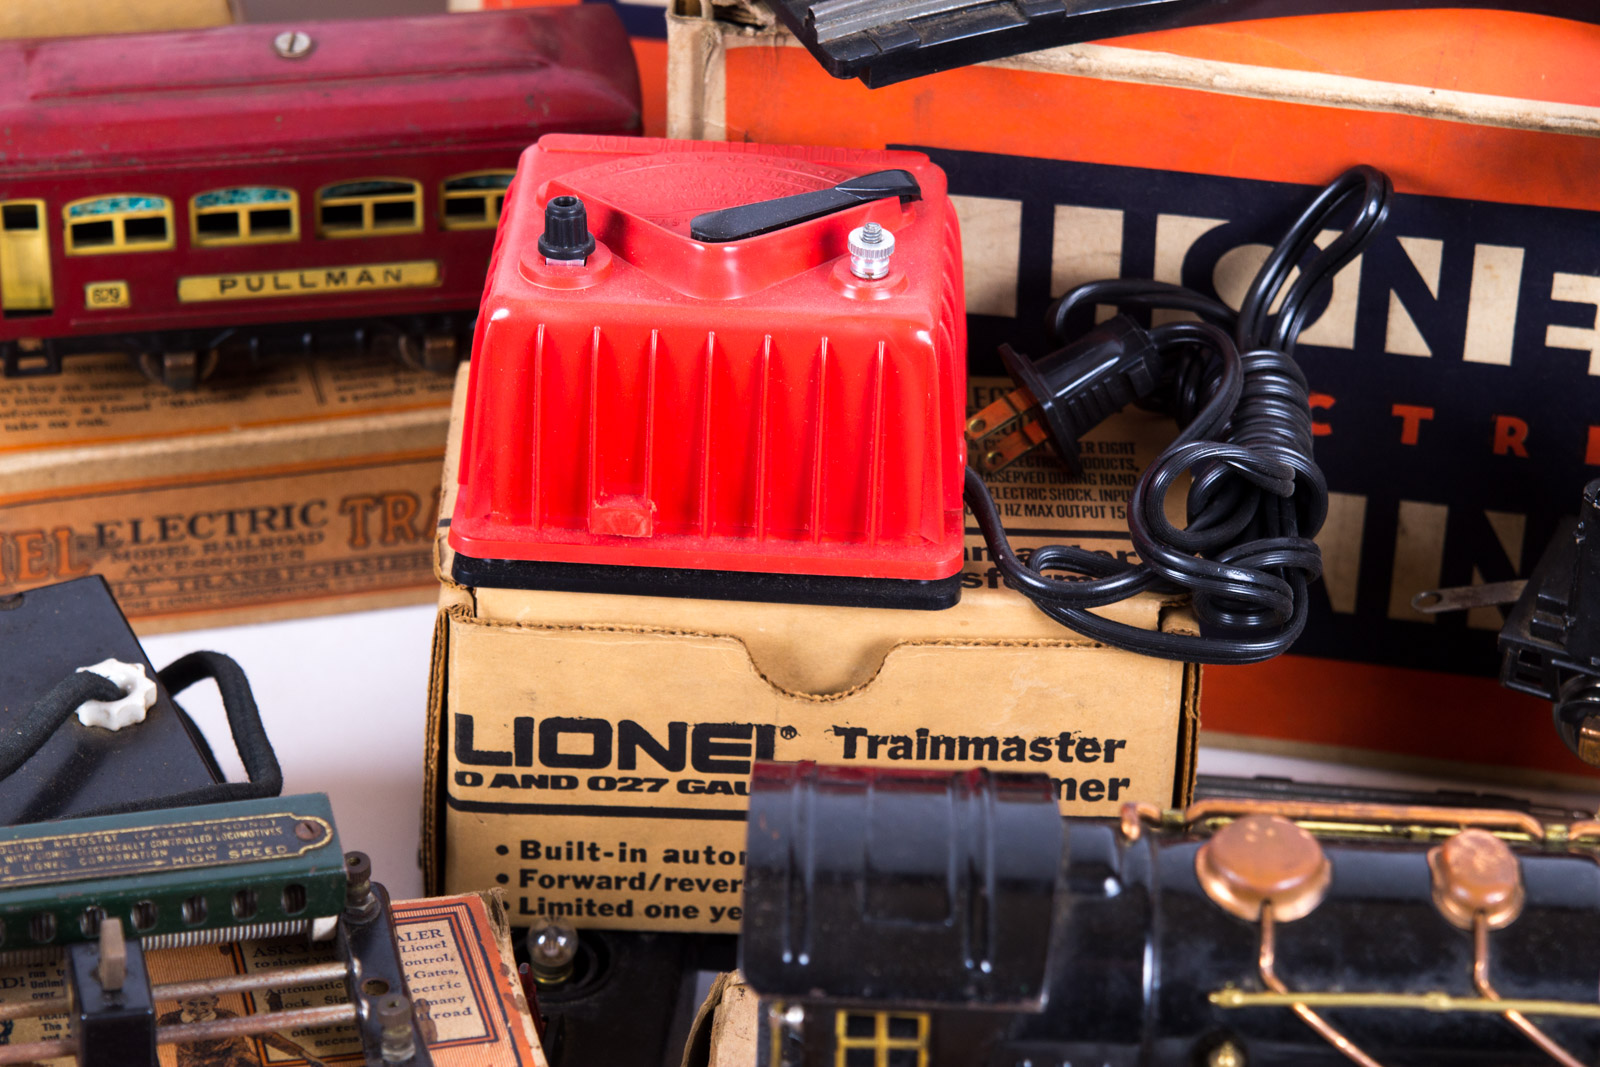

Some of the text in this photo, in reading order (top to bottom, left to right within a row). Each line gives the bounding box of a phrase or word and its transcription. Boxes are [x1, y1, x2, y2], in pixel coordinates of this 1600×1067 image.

[219, 268, 402, 294] PULLMAN
[1098, 442, 1136, 456] EIGHT
[1080, 457, 1140, 472] ODUCTS,
[988, 487, 1049, 500] ELECTRIC
[1050, 488, 1097, 501] SHOCK.
[1005, 503, 1021, 516] HZ
[1024, 505, 1056, 517] MAX
[1056, 505, 1107, 518] OUTPUT
[95, 499, 329, 549] ELECTRIC
[202, 530, 325, 558] RAILROAD
[832, 725, 1127, 763] Trainmaster
[488, 773, 579, 790] AND
[53, 834, 118, 847] RHEOSTAT
[150, 834, 213, 849] CONTROLLED
[216, 826, 283, 841] LOCOMOTIVES
[171, 844, 289, 866] HIGH SPEED
[520, 839, 647, 863] Built-in
[22, 861, 68, 873] LIONEL
[79, 849, 169, 866] CORPORATION
[518, 868, 743, 894] Forward/rever
[518, 897, 743, 924] Limited one ye
[253, 944, 294, 958] ASK
[400, 940, 448, 953] Lionel
[254, 961, 270, 969] to
[272, 956, 310, 967] show
[401, 953, 455, 967] ontrol,
[413, 968, 459, 980] Gates,
[264, 981, 344, 998] Automatic
[426, 995, 466, 1006] many
[291, 1026, 332, 1038] other
